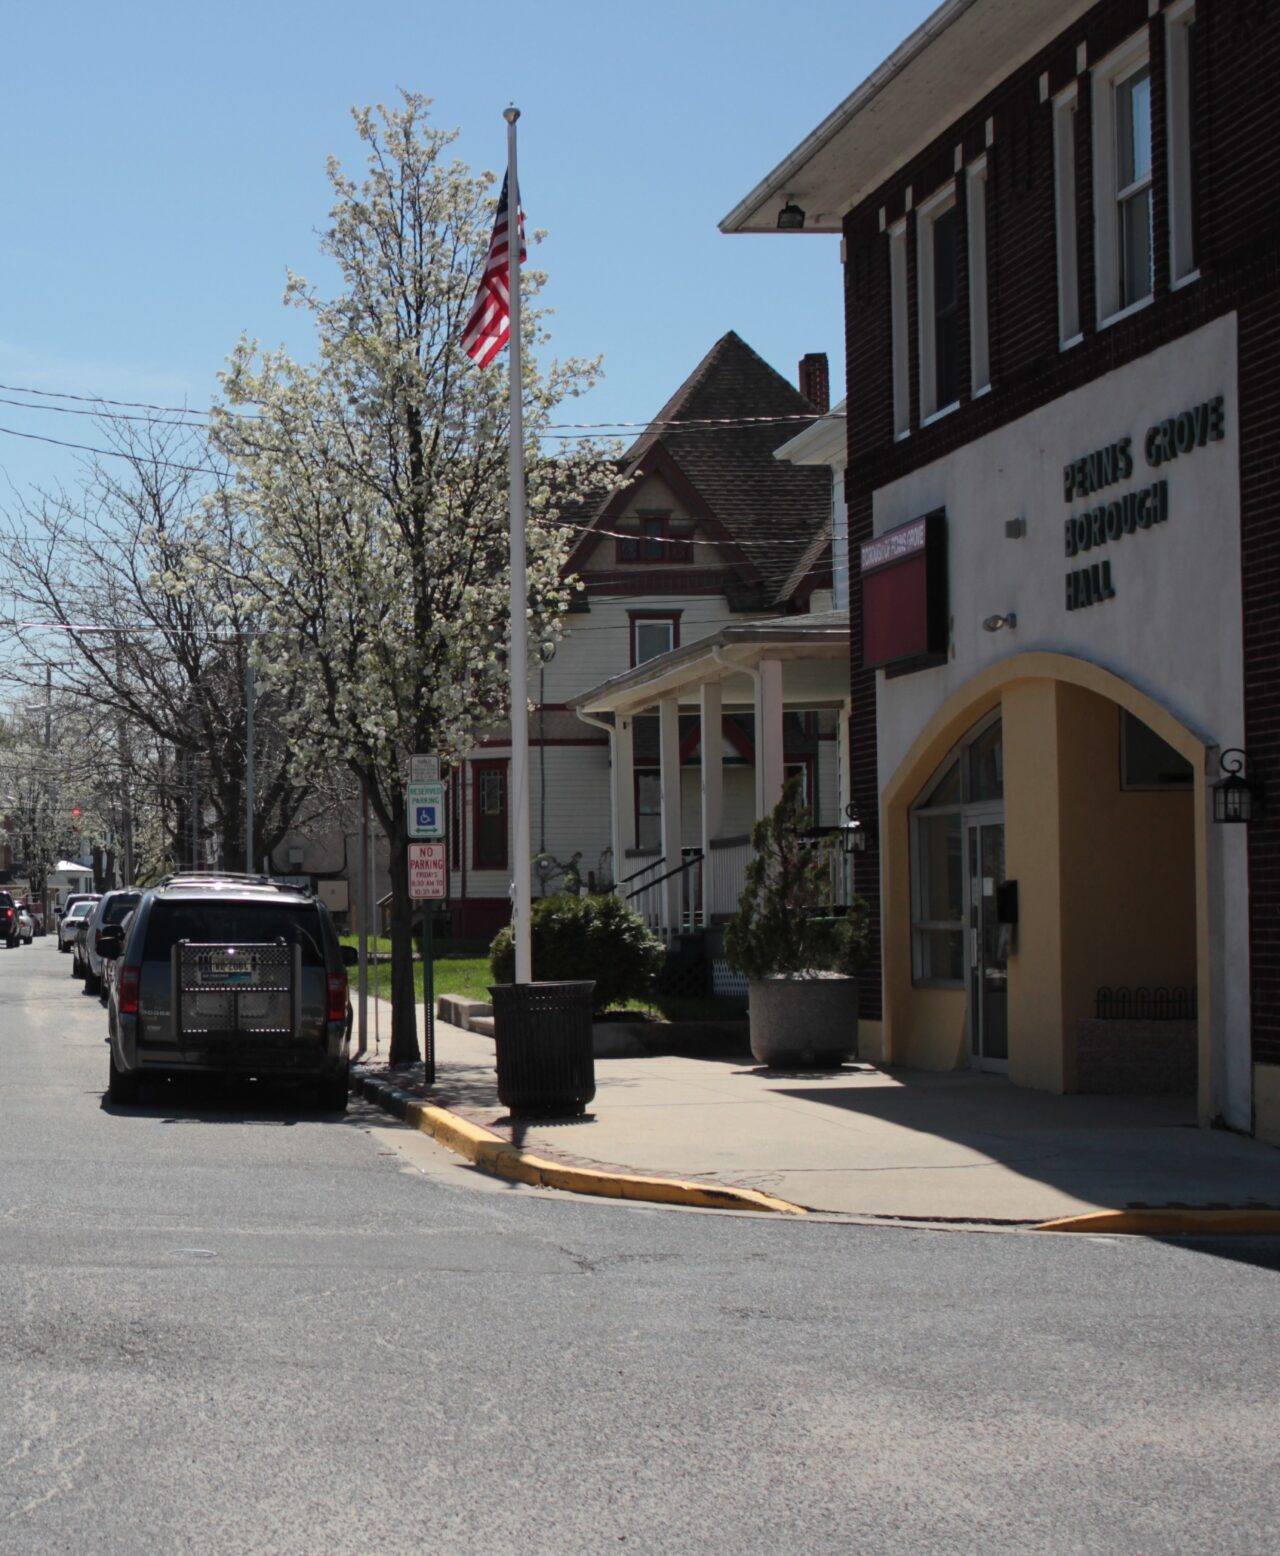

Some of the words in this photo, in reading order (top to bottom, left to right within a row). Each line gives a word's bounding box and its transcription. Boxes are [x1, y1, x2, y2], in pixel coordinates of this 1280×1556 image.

[1064, 436, 1133, 503] PENNS
[1144, 395, 1225, 467] GROVE
[1064, 479, 1169, 558] BOROUGH
[1065, 559, 1116, 611] HALL
[410, 787, 441, 795] RESERVED
[410, 859, 443, 869] PARKING
[420, 847, 433, 857] NO
